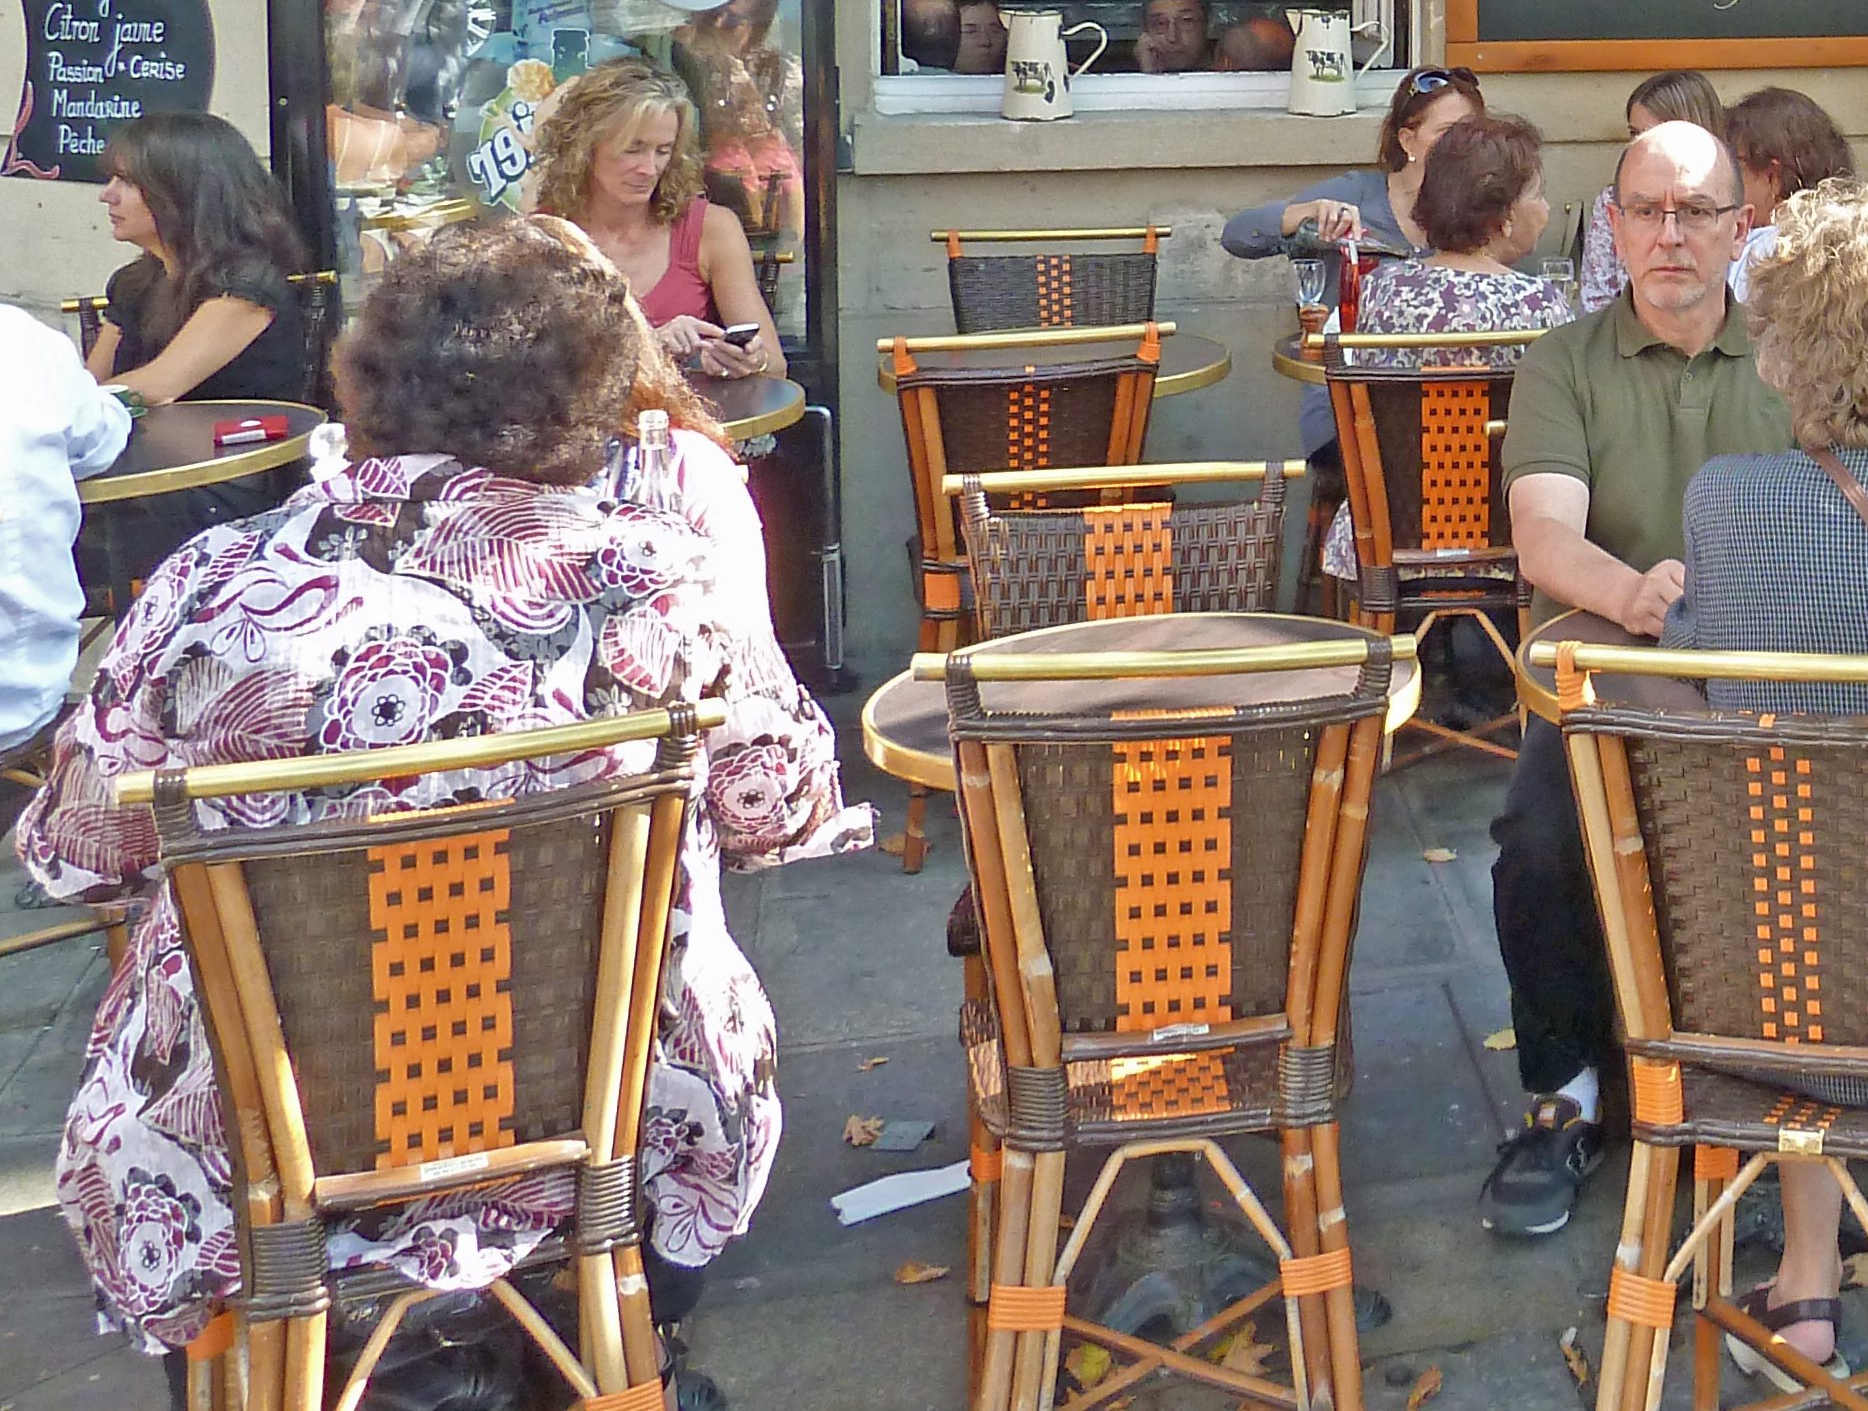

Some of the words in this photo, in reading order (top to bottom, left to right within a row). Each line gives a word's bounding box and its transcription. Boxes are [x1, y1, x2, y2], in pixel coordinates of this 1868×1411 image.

[43, 2, 102, 45] Citron
[105, 13, 165, 78] jaune
[47, 51, 105, 83] Passion
